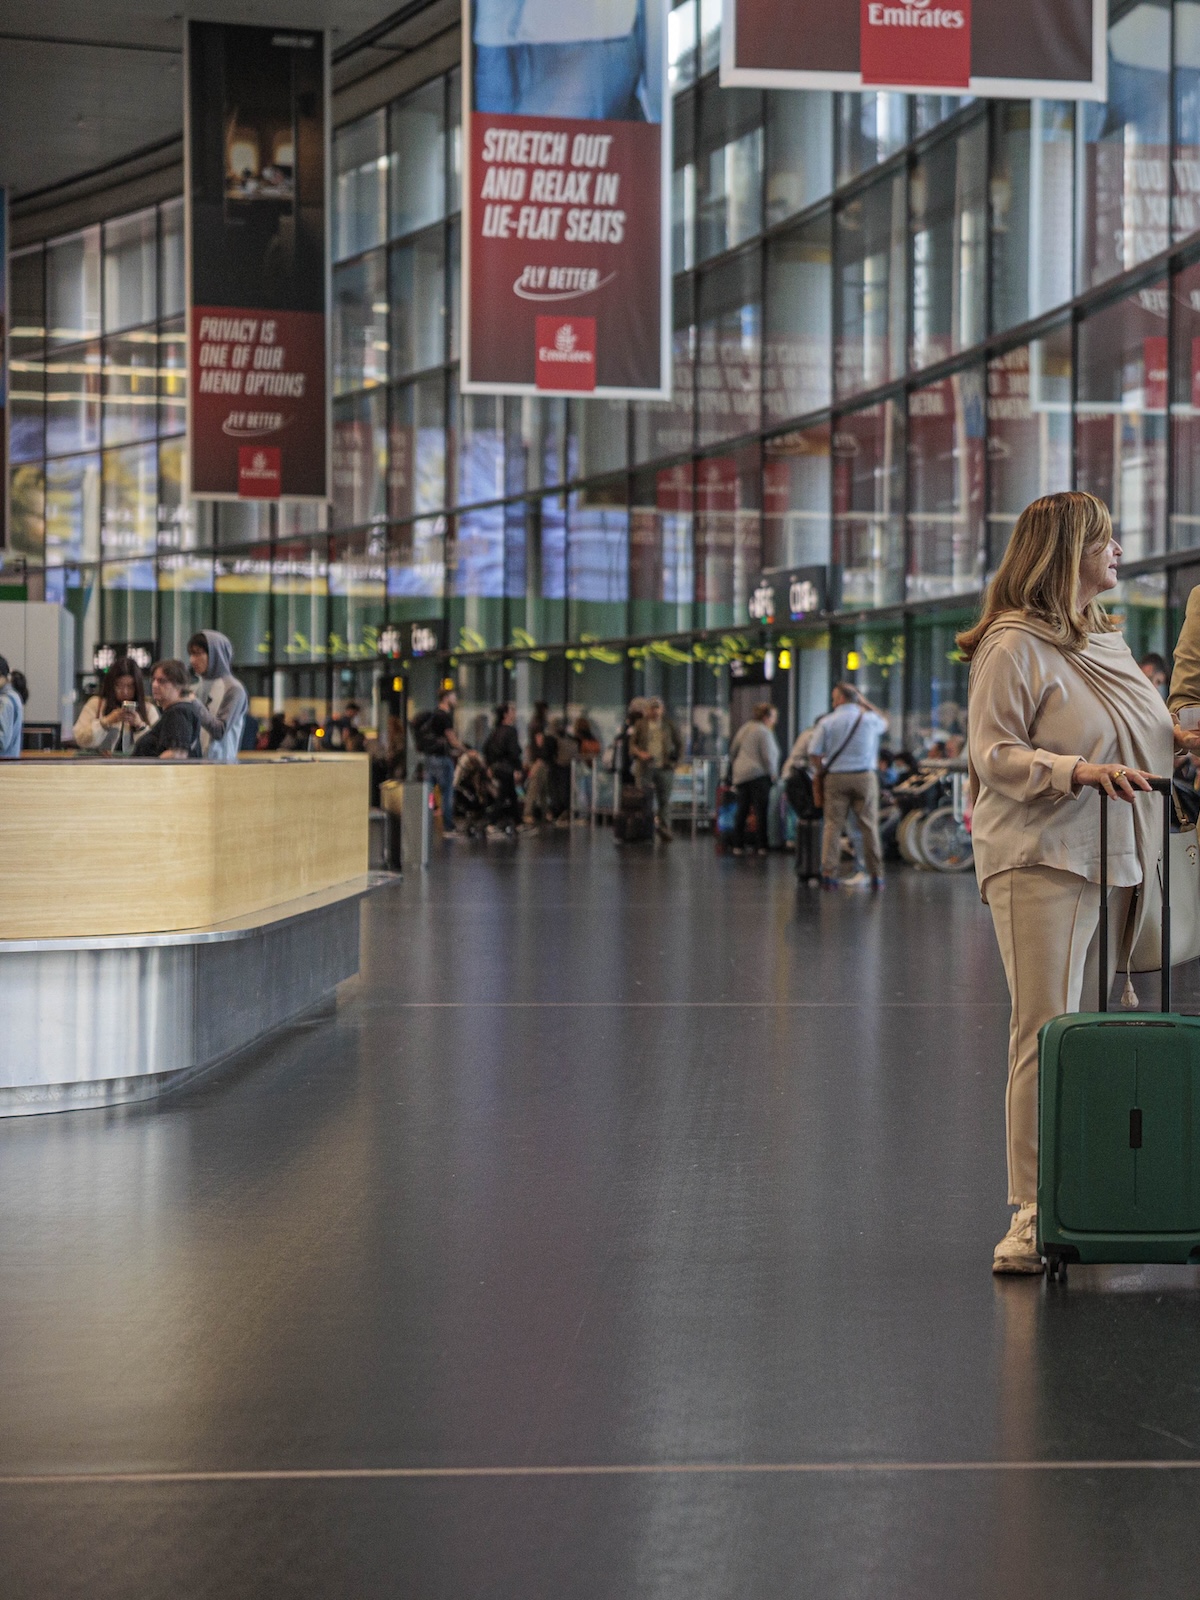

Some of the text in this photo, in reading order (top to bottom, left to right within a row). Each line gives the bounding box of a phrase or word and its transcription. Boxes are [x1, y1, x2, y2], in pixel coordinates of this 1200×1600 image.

[868, 3, 964, 29] Emirates
[482, 128, 612, 168] STRETCH OUT
[481, 166, 620, 206] AND RELAX IN
[481, 203, 627, 244] LIE-FLAT SEATS
[521, 265, 599, 291] FLY BETTER
[199, 316, 276, 344] PRIVACY IS
[199, 342, 284, 370] ONE OF OUR
[538, 347, 594, 363] Emirates
[199, 370, 305, 397] MENU OPTIONS
